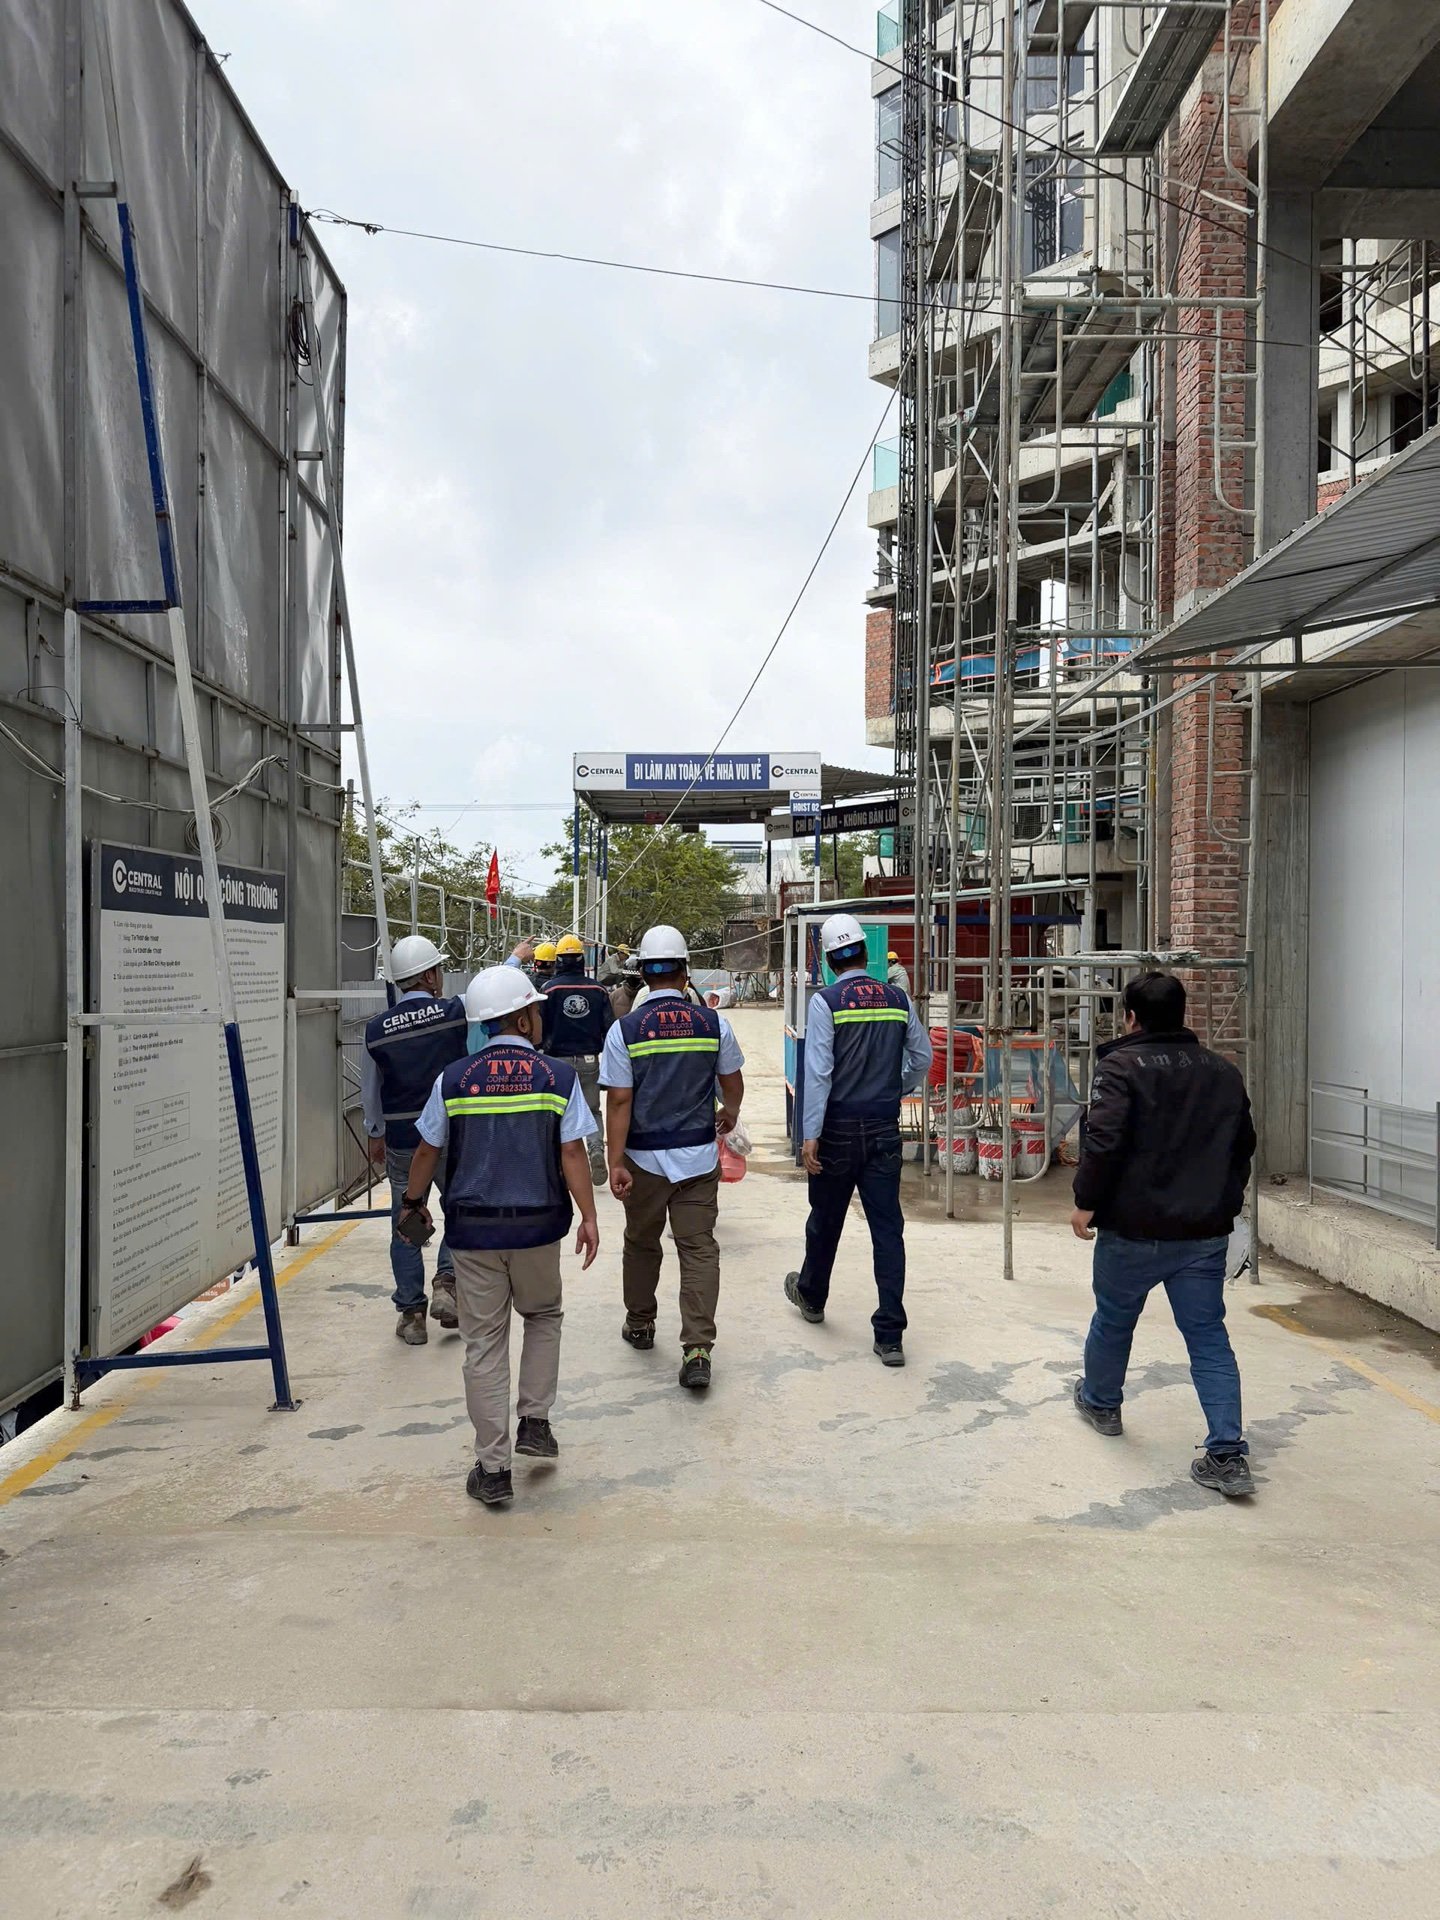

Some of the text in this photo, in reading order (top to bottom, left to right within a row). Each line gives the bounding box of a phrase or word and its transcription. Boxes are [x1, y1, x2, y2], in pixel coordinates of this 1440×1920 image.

[634, 763, 643, 780] ĐI
[645, 760, 663, 780] LÀM
[664, 763, 677, 780] AN
[717, 760, 734, 780] NHÀ
[736, 763, 749, 780] VUI
[751, 758, 762, 780] VẺ
[793, 803, 820, 812] HOIST 02
[127, 870, 163, 889] CENTRAL
[175, 868, 194, 905] NỘI
[220, 874, 243, 904] CÔNG
[246, 881, 278, 910] TRƯỜNG
[854, 984, 885, 996] TVN
[382, 1004, 444, 1028] CENTRAL
[657, 1011, 692, 1023] TVN
[487, 1060, 534, 1075] TVN
[487, 1075, 510, 1083] CONS
